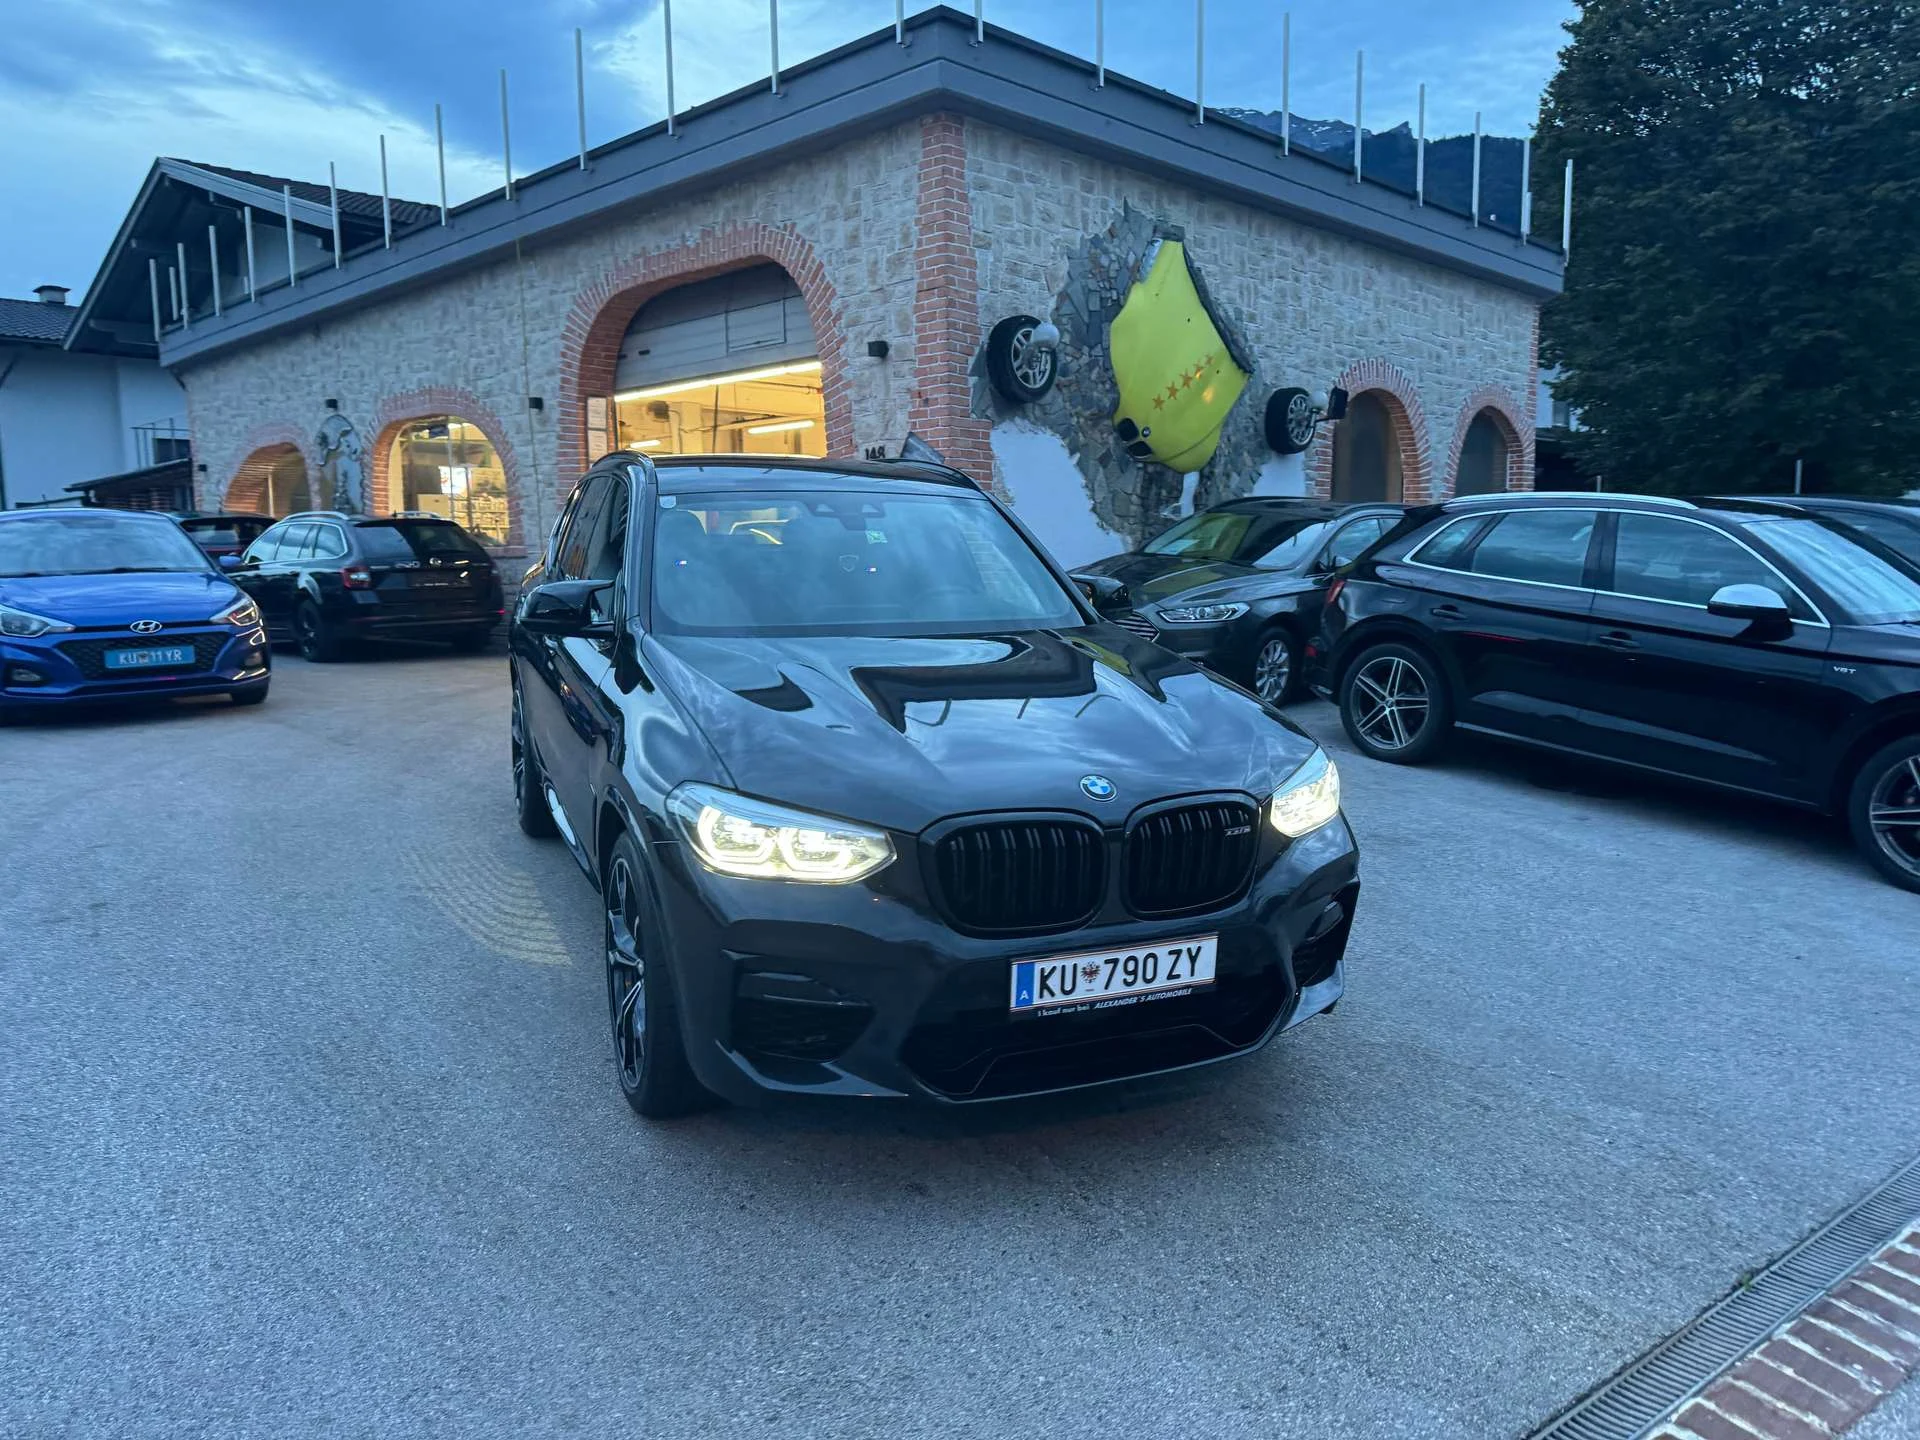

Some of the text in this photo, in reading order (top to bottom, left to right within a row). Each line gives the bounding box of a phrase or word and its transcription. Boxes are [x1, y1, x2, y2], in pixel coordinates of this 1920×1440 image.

[119, 648, 182, 665] KU 11 YR
[1038, 945, 1202, 999] KU 790 ZY
[1019, 989, 1030, 1001] A
[1145, 988, 1193, 1002] AUTOMOBILE
